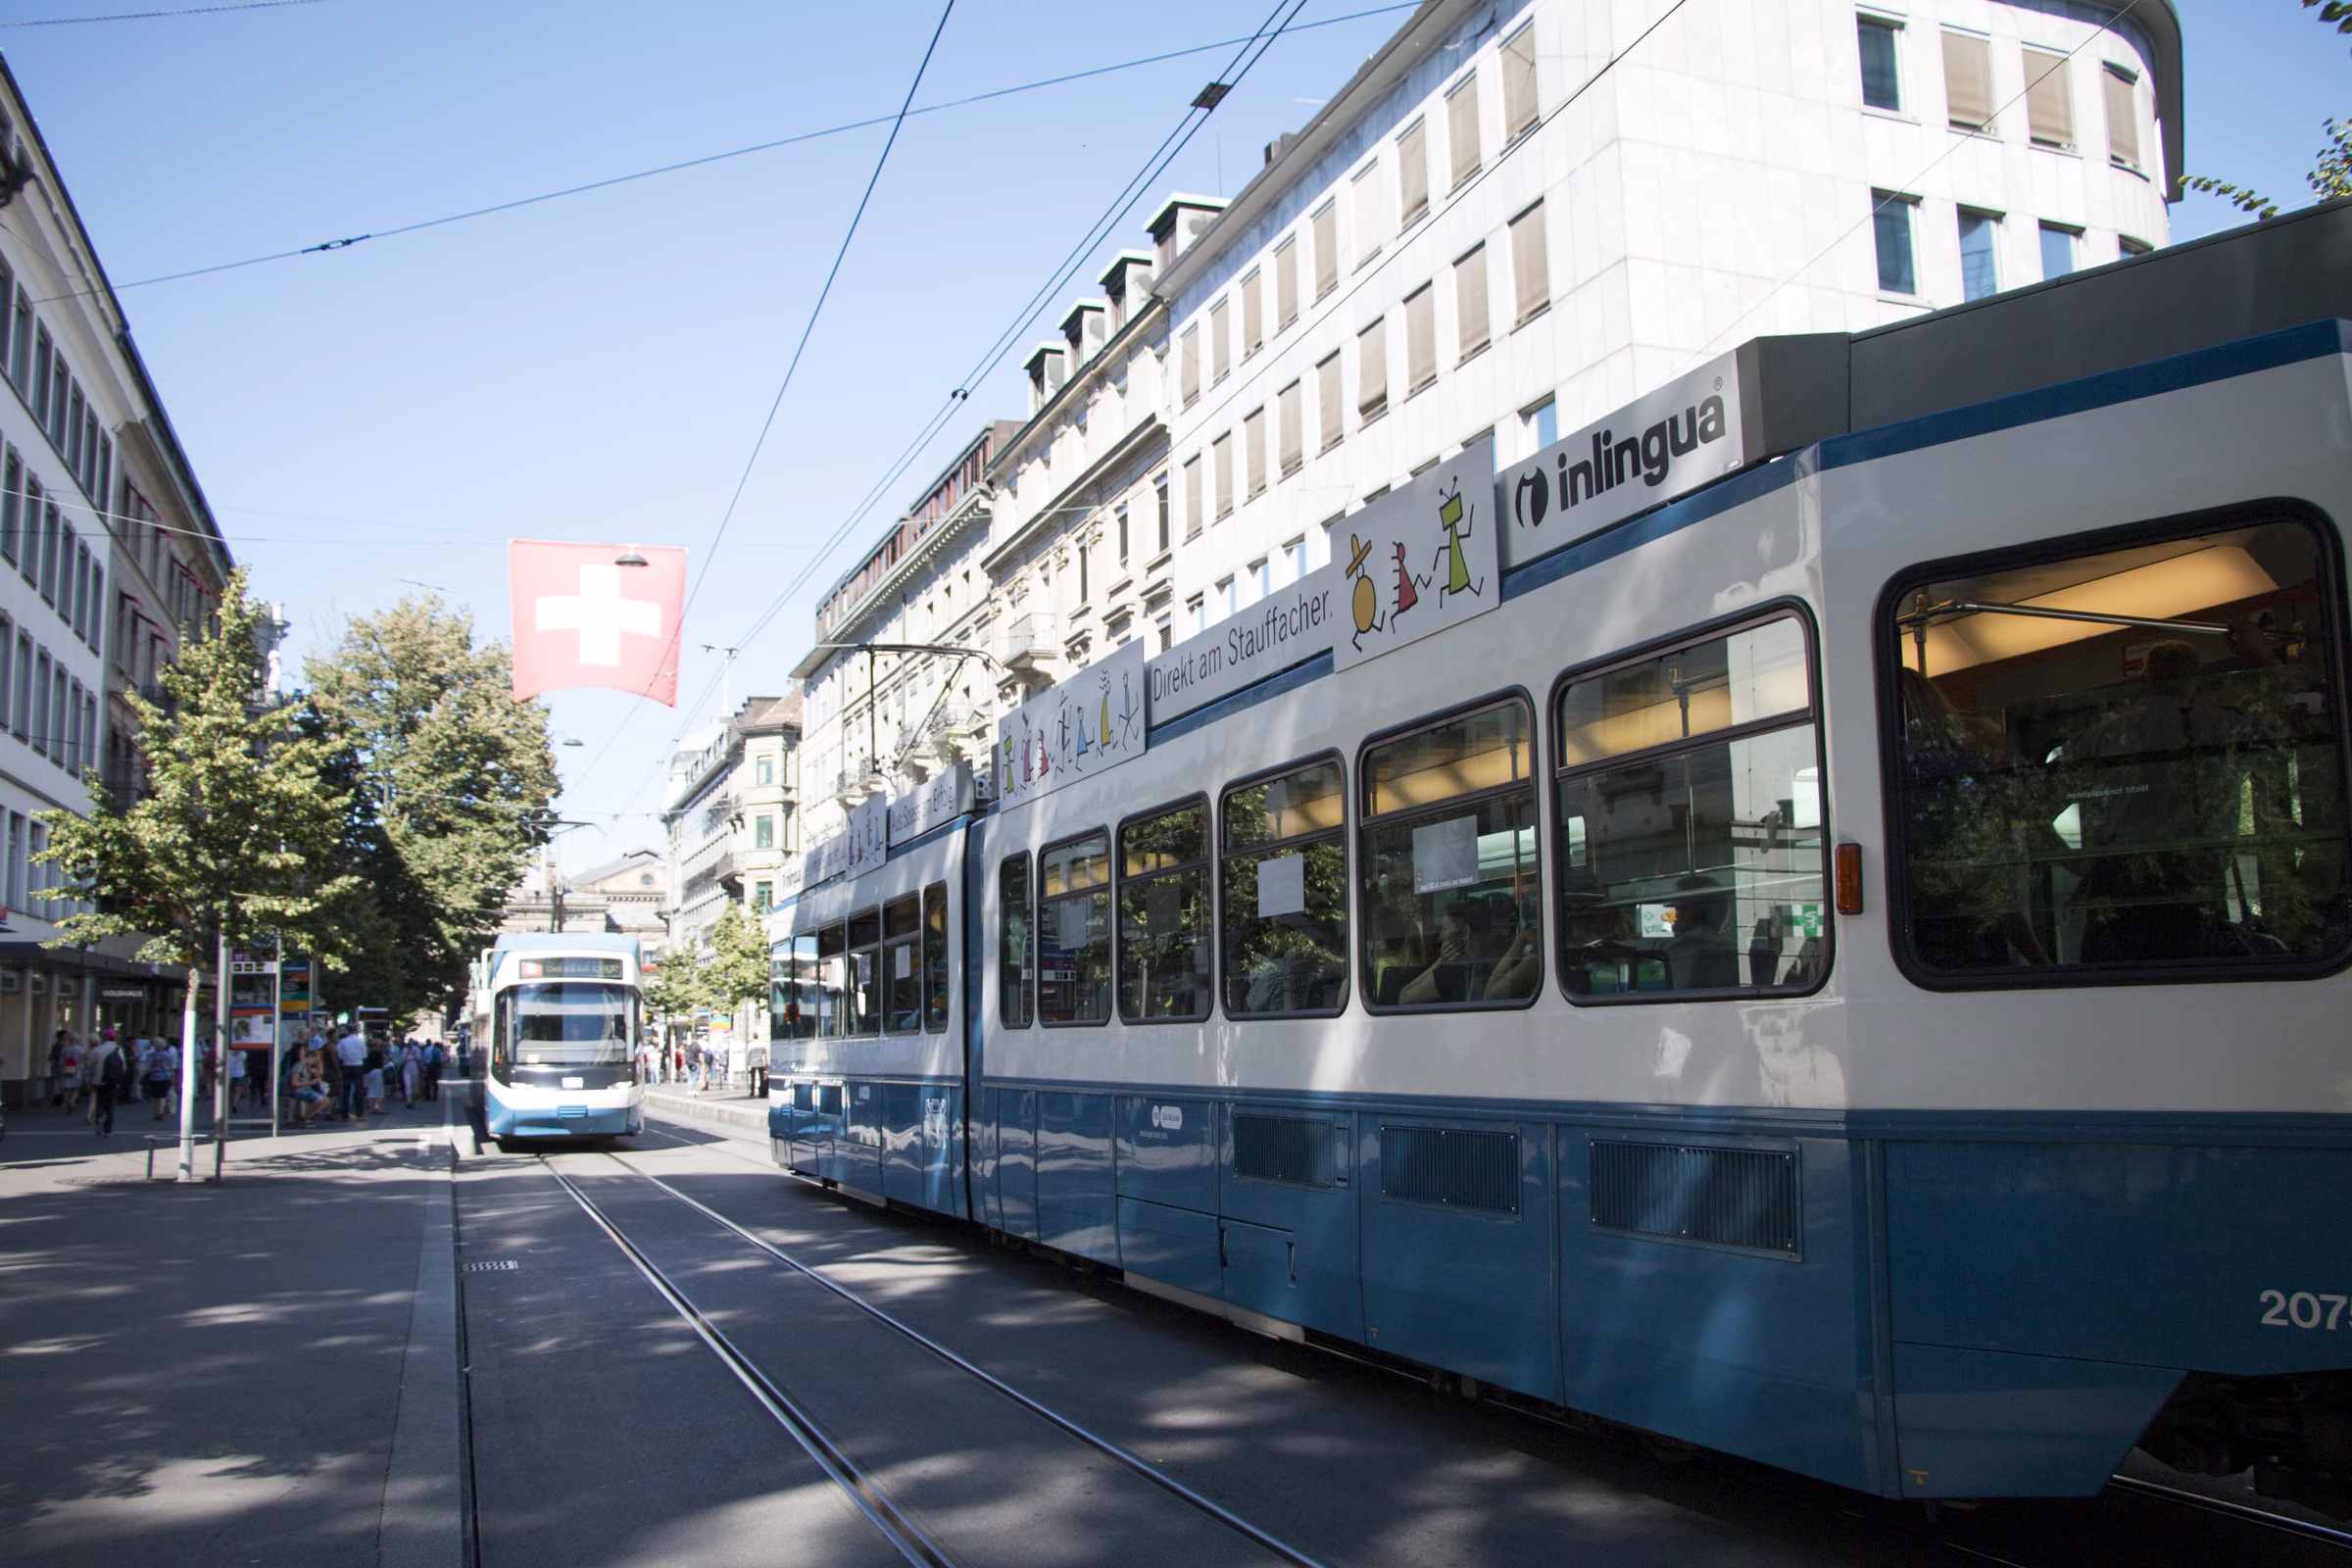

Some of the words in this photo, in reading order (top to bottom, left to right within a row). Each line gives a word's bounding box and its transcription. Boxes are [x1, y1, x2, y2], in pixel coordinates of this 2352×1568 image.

[1557, 394, 1726, 512] inlingua
[1153, 652, 1194, 703] Direkt
[1199, 644, 1222, 680] am
[1227, 590, 1334, 666] Stauffacher.
[2259, 1289, 2352, 1330] 207
